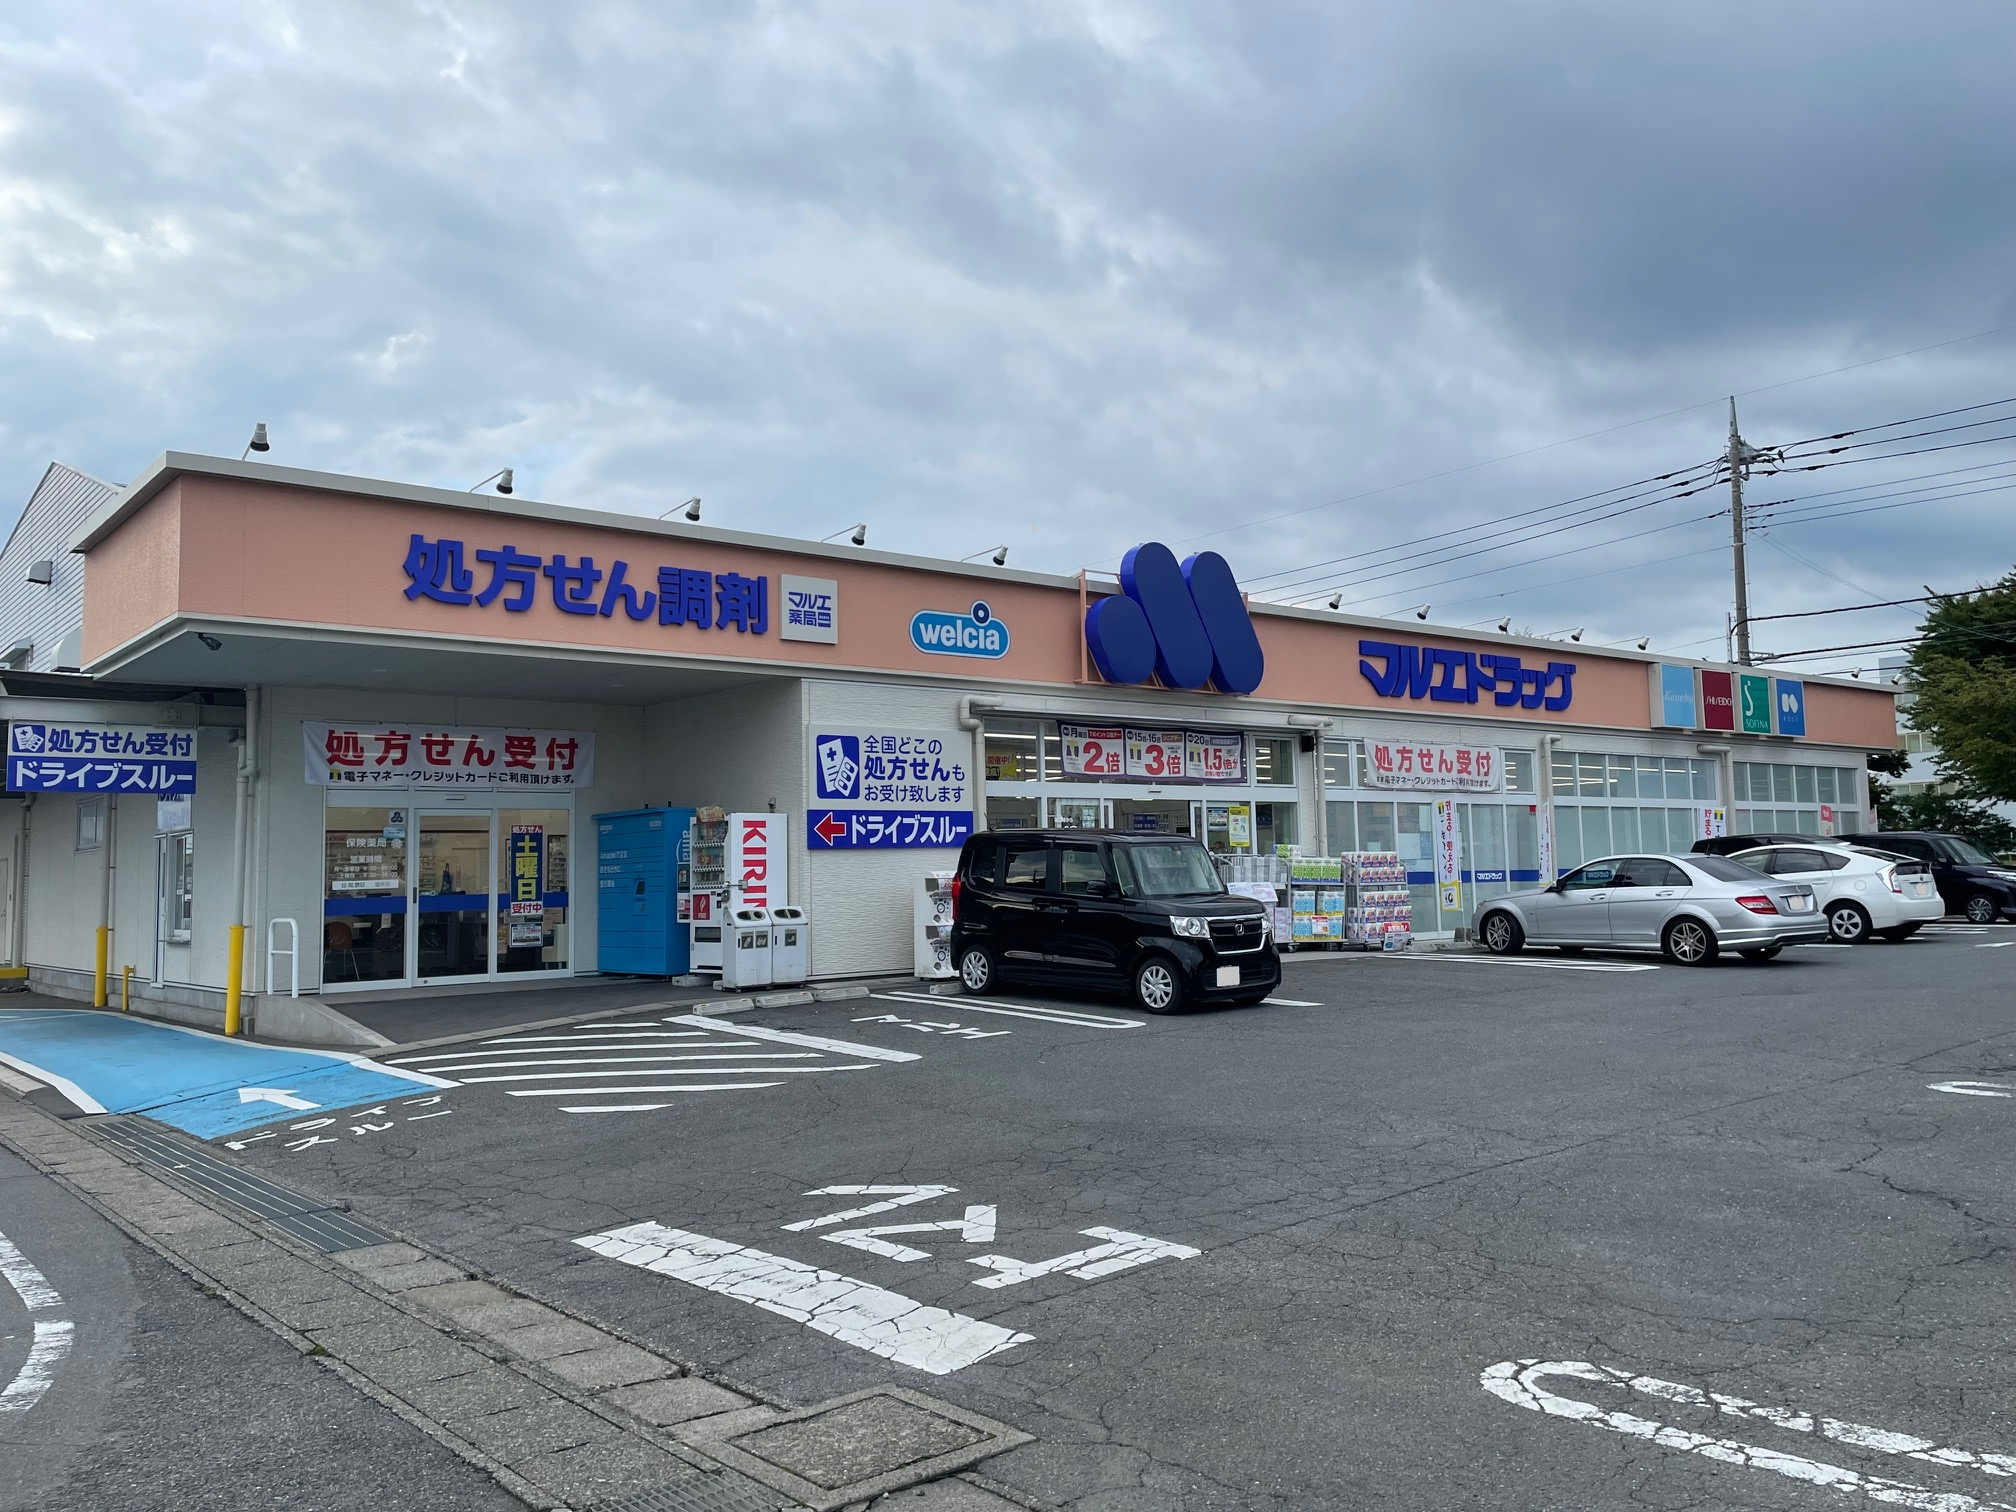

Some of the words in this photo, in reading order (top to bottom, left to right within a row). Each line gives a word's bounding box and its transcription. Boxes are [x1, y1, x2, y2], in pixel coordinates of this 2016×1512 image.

[402, 534, 769, 634] 処方せん調剤
[788, 591, 832, 612] マルエ
[788, 609, 817, 627] 薬局
[918, 617, 1000, 651] welcia
[1359, 640, 1577, 711] マルエドラッグ
[1664, 690, 1694, 704] Kanebo
[1705, 695, 1732, 707] SHISEIDO
[1745, 719, 1769, 730] SOFINA
[48, 728, 193, 757] 処方せん受付
[325, 729, 579, 771] 処方せん受付
[864, 735, 943, 755] 全国どこの
[864, 755, 966, 782] 処方せんも
[1375, 745, 1491, 777] 処方せん受付
[15, 761, 194, 790] ドライブスルー
[864, 784, 965, 803] お受け致します
[346, 838, 387, 847] 保険薬局
[851, 813, 967, 845] ドライブスルー
[516, 835, 538, 900] 土曜日
[512, 903, 542, 914] 受付中
